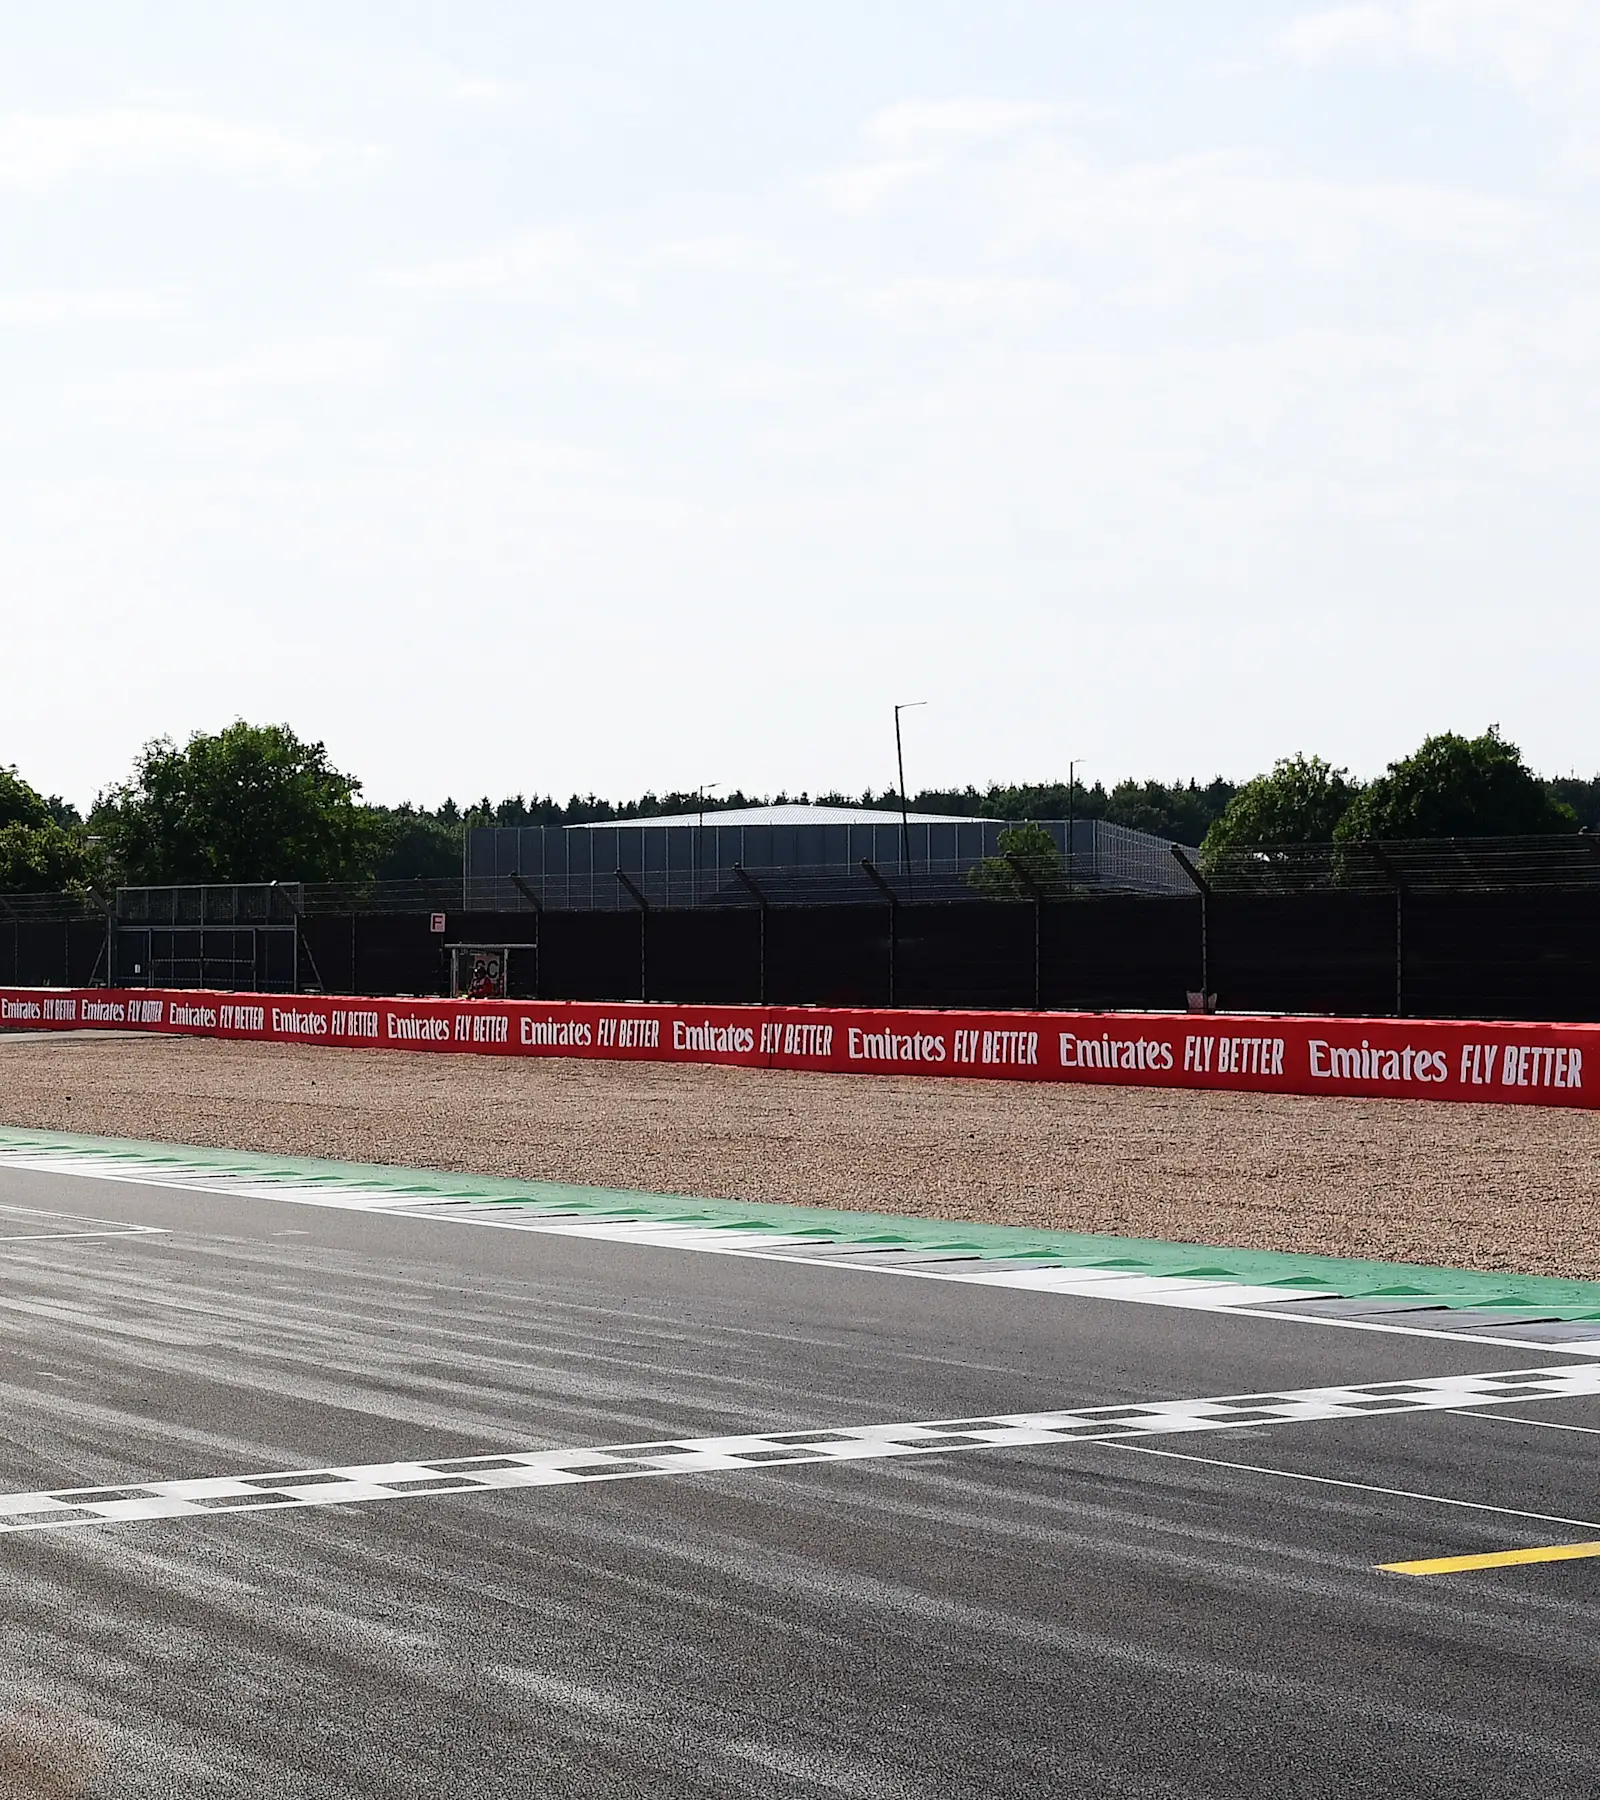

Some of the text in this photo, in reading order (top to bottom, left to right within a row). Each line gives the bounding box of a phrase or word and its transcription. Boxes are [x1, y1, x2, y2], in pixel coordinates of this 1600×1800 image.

[432, 915, 443, 930] F
[1, 998, 41, 1020] Emirates
[81, 999, 125, 1022] Emirates
[169, 1002, 264, 1030] Emirates FLY BETTER
[272, 1008, 379, 1038] Emirates FLY BETTER
[387, 1013, 508, 1043] Emirates FLY BETTER
[520, 1017, 660, 1048] Emirates FLY BETTER
[672, 1020, 833, 1056] Emirates FLY BETTER
[848, 1027, 1038, 1065] Emirates FLY BETTER
[1059, 1033, 1284, 1075] Emirates FLY BETTER
[1308, 1039, 1583, 1088] Emirates FLY BETTER
